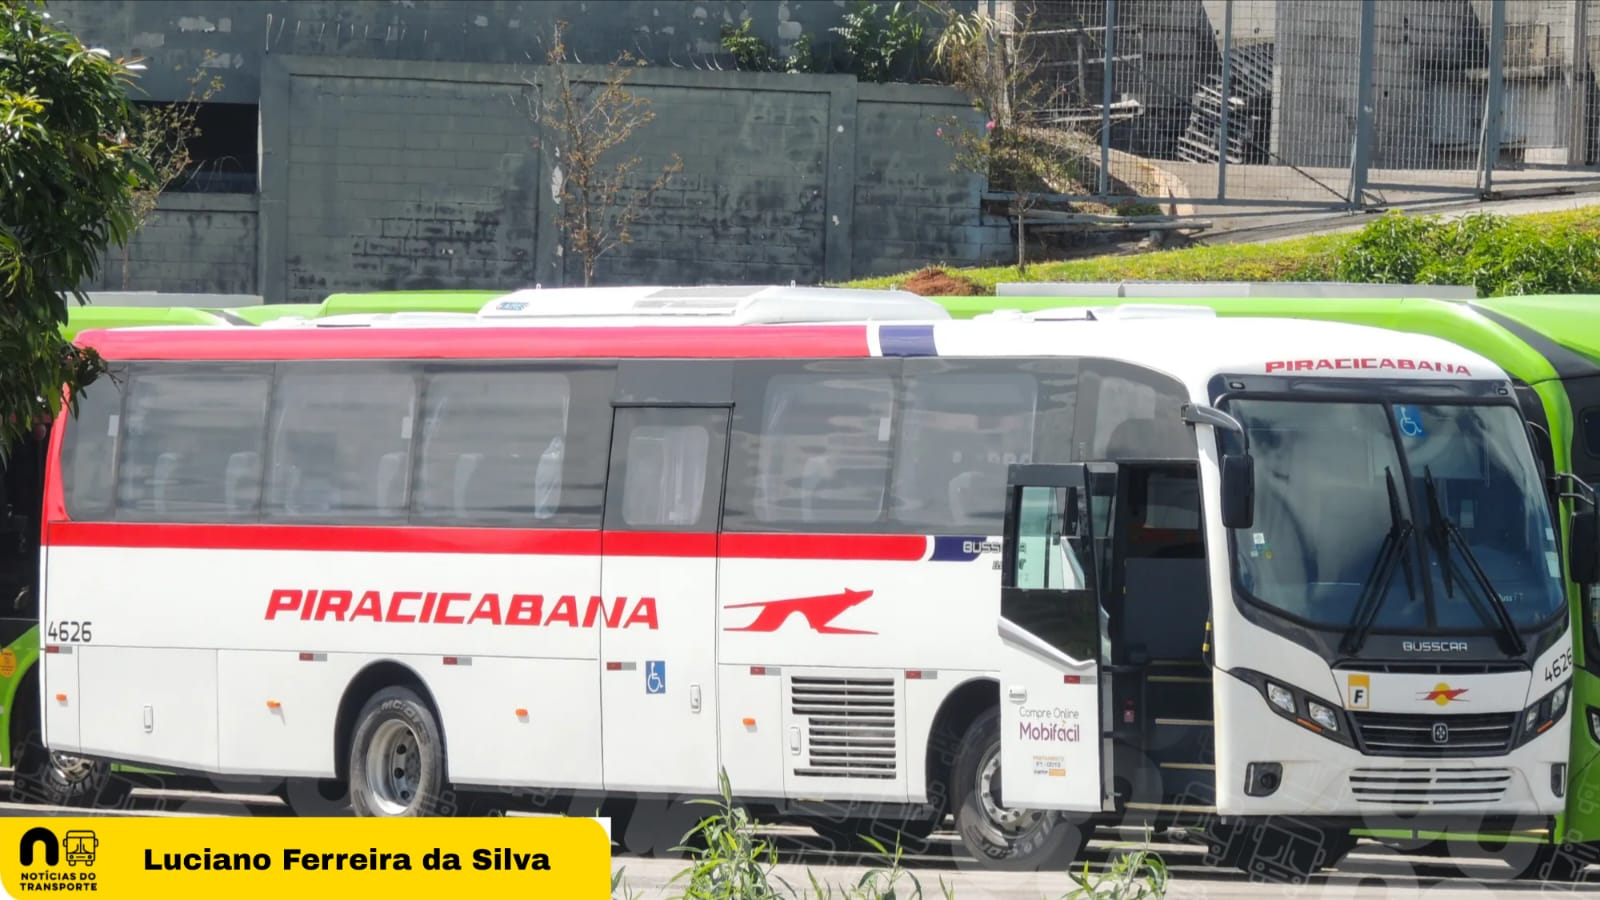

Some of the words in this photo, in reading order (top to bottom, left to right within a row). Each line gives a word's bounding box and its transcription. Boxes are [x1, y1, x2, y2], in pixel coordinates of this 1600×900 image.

[1265, 358, 1472, 377] PIRACICABANA
[264, 589, 660, 630] PIRACICABANA
[47, 621, 93, 642] 4626
[1402, 641, 1469, 652] BUSSCAR
[1353, 689, 1364, 704] F
[1019, 706, 1052, 719] Compre
[1053, 707, 1080, 719] Online
